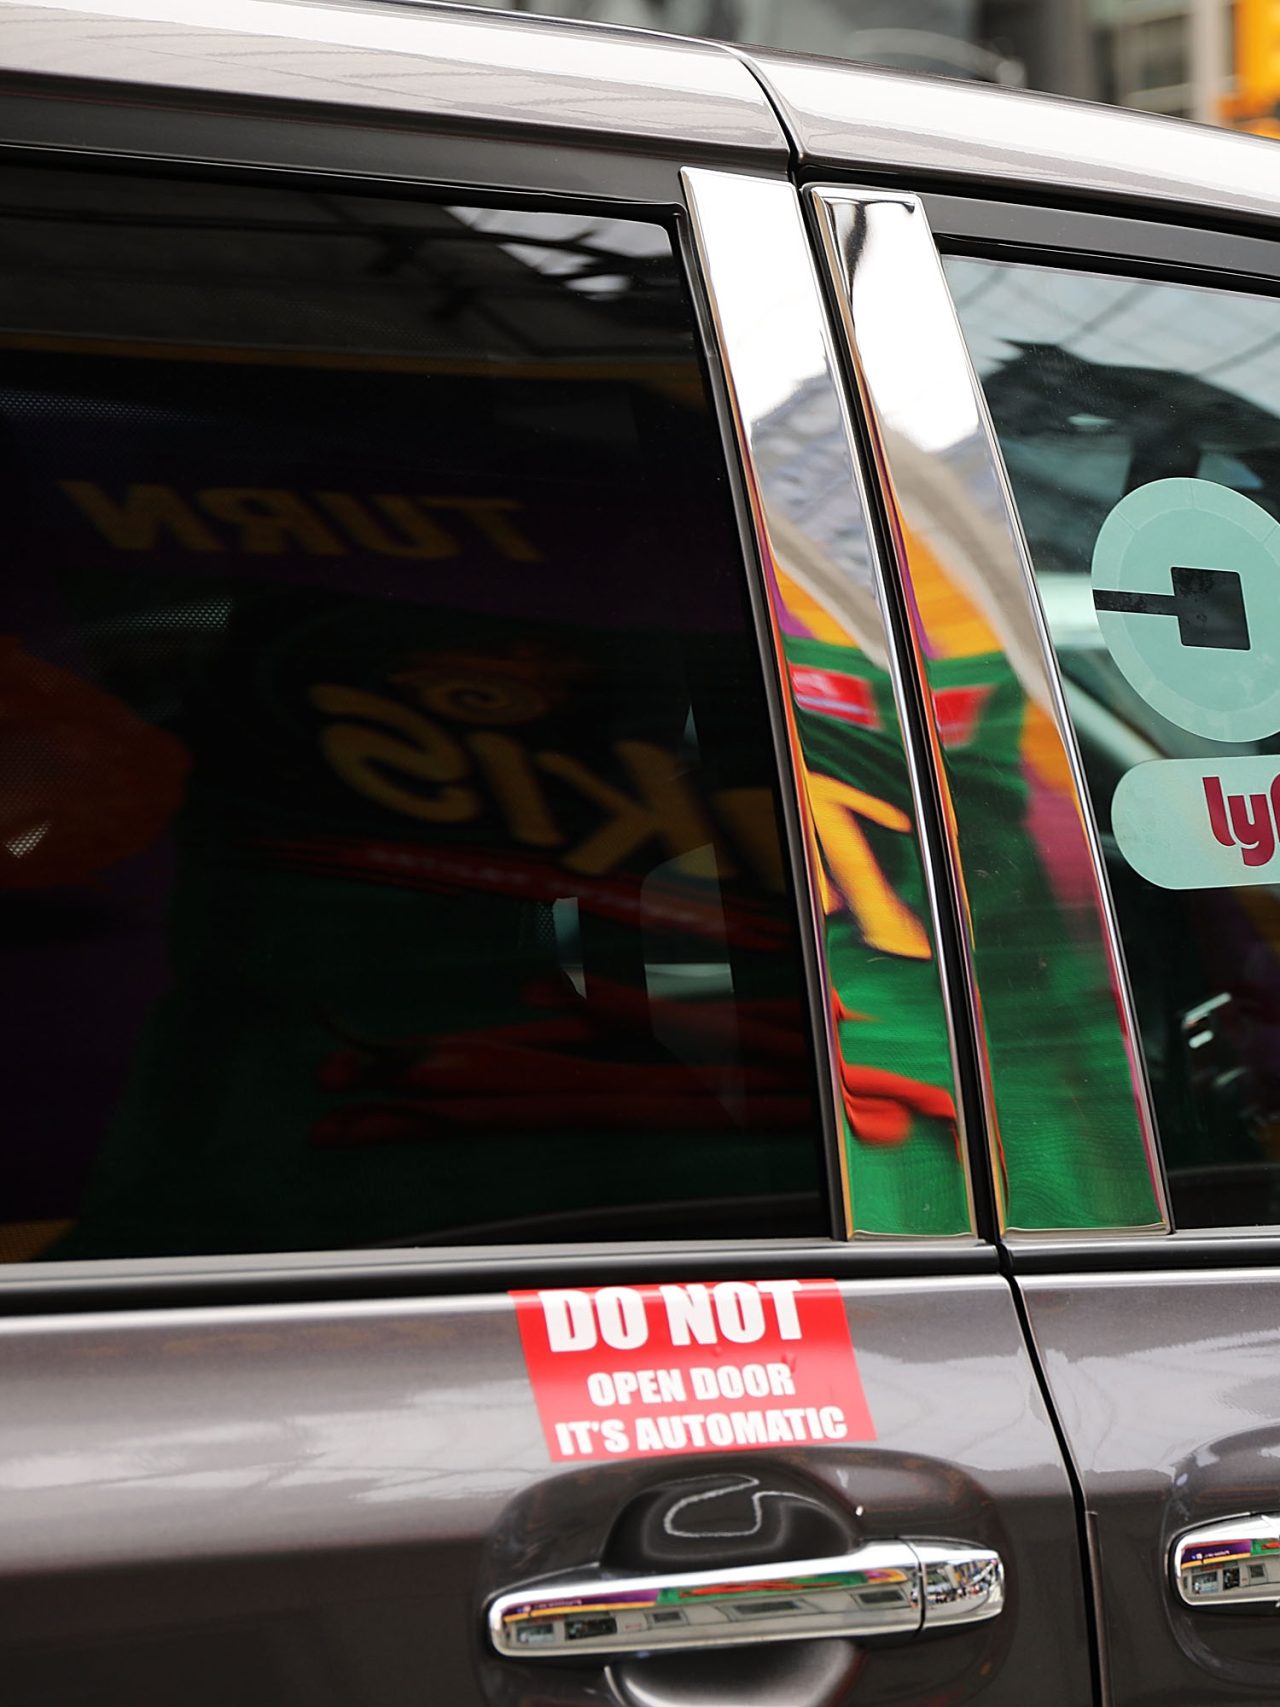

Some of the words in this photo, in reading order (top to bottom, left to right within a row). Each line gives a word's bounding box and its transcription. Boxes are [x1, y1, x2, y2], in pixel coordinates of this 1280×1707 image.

[538, 1286, 649, 1353] DO
[659, 1280, 803, 1347] NOT
[587, 1368, 688, 1407] OPEN
[690, 1362, 796, 1401] DOOR
[555, 1419, 630, 1455] IT'S
[635, 1406, 848, 1451] AUTOMATIC
